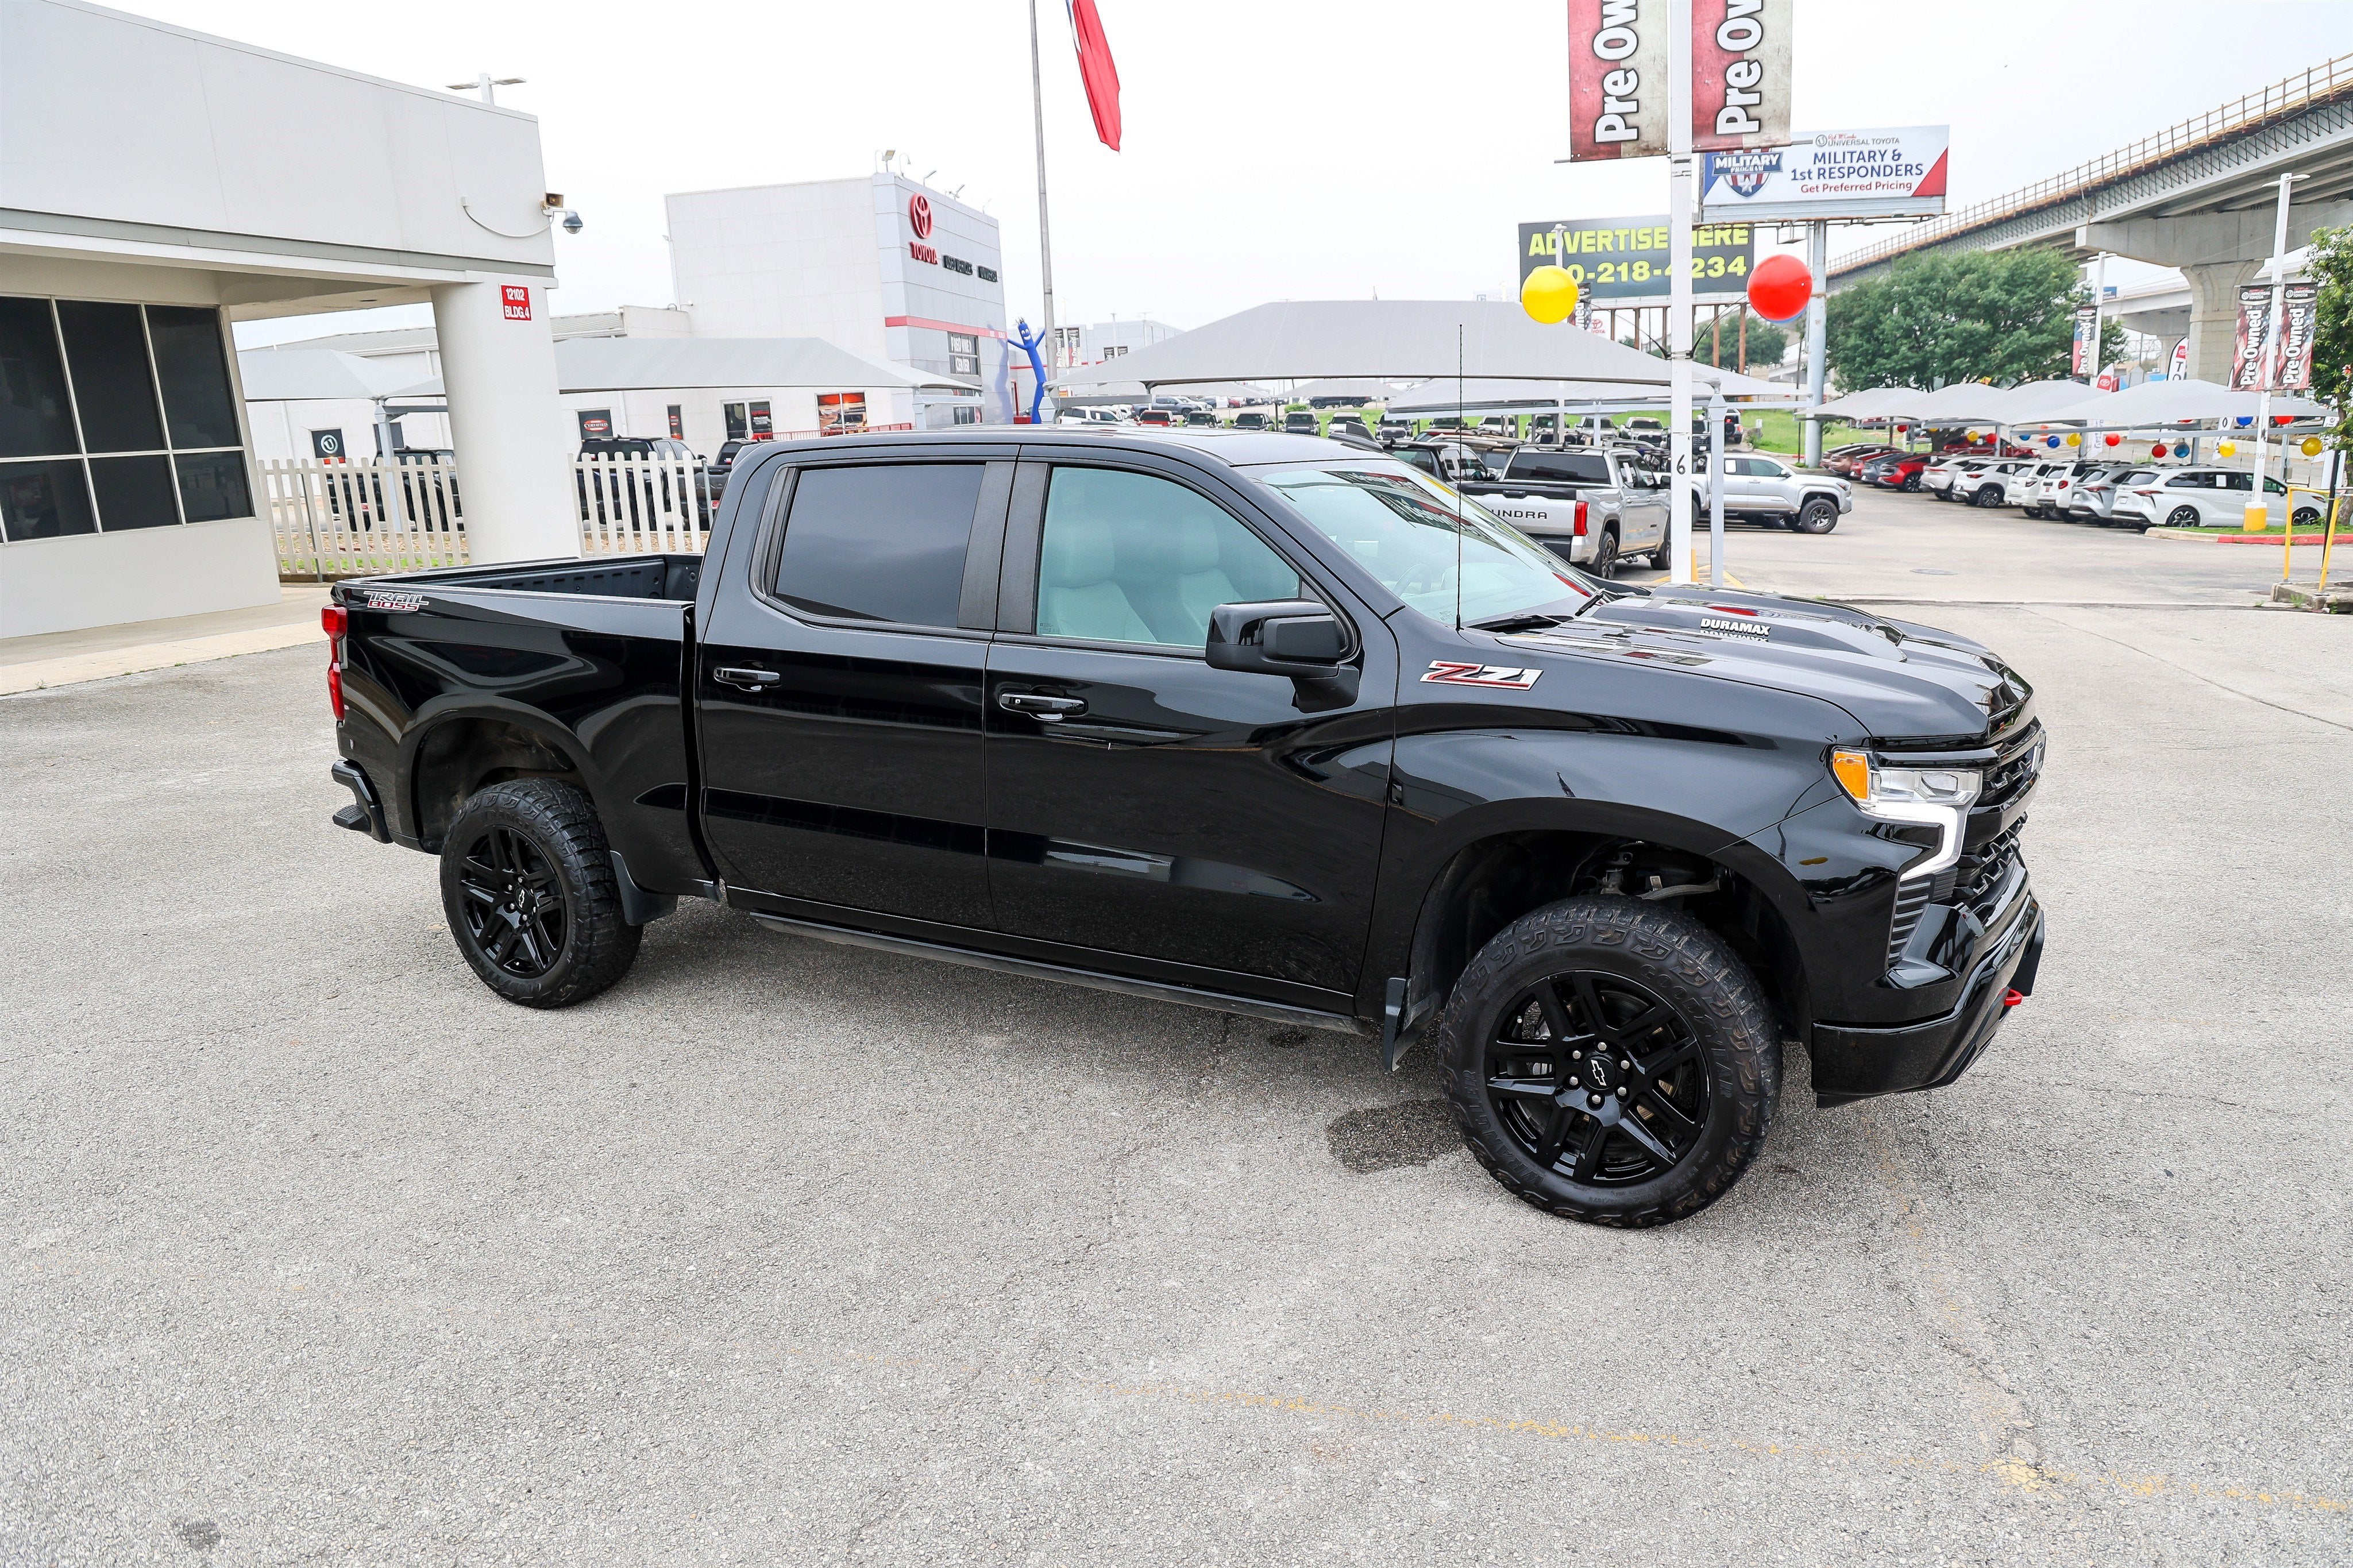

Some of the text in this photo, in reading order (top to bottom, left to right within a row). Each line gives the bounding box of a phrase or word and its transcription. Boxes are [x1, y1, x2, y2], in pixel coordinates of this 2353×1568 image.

[1595, 68, 1639, 143] Pre
[1716, 59, 1762, 135] Pre
[1828, 138, 1870, 146] UNIVERSAL
[1715, 153, 1780, 169] MILITARY
[1814, 148, 1903, 165] MILITARY &
[1730, 164, 1765, 173] PROGRAM
[1791, 163, 1924, 181] 1st RESPONDERS
[1800, 180, 1912, 194] Get Preferred Pricing
[1528, 226, 1669, 257] ADVERTISE
[909, 241, 938, 264] TOYOTA
[506, 288, 526, 301] 12102
[2078, 322, 2092, 356] Owned
[2243, 310, 2262, 360] Owned
[2285, 308, 2305, 358] Owned
[2077, 356, 2089, 374] Pre
[2240, 360, 2257, 385] Pre
[2283, 358, 2300, 384] Pre
[1676, 454, 1686, 475] 6
[1491, 509, 1548, 519] UNDRA
[364, 590, 429, 605] TRAIL
[368, 600, 420, 611] BOSS
[1700, 618, 1771, 636] DURAMAX
[1419, 659, 1545, 692] Z71
[1641, 964, 1733, 1098] GOODYEAR
[1463, 1069, 1544, 1187] WRANGLER
